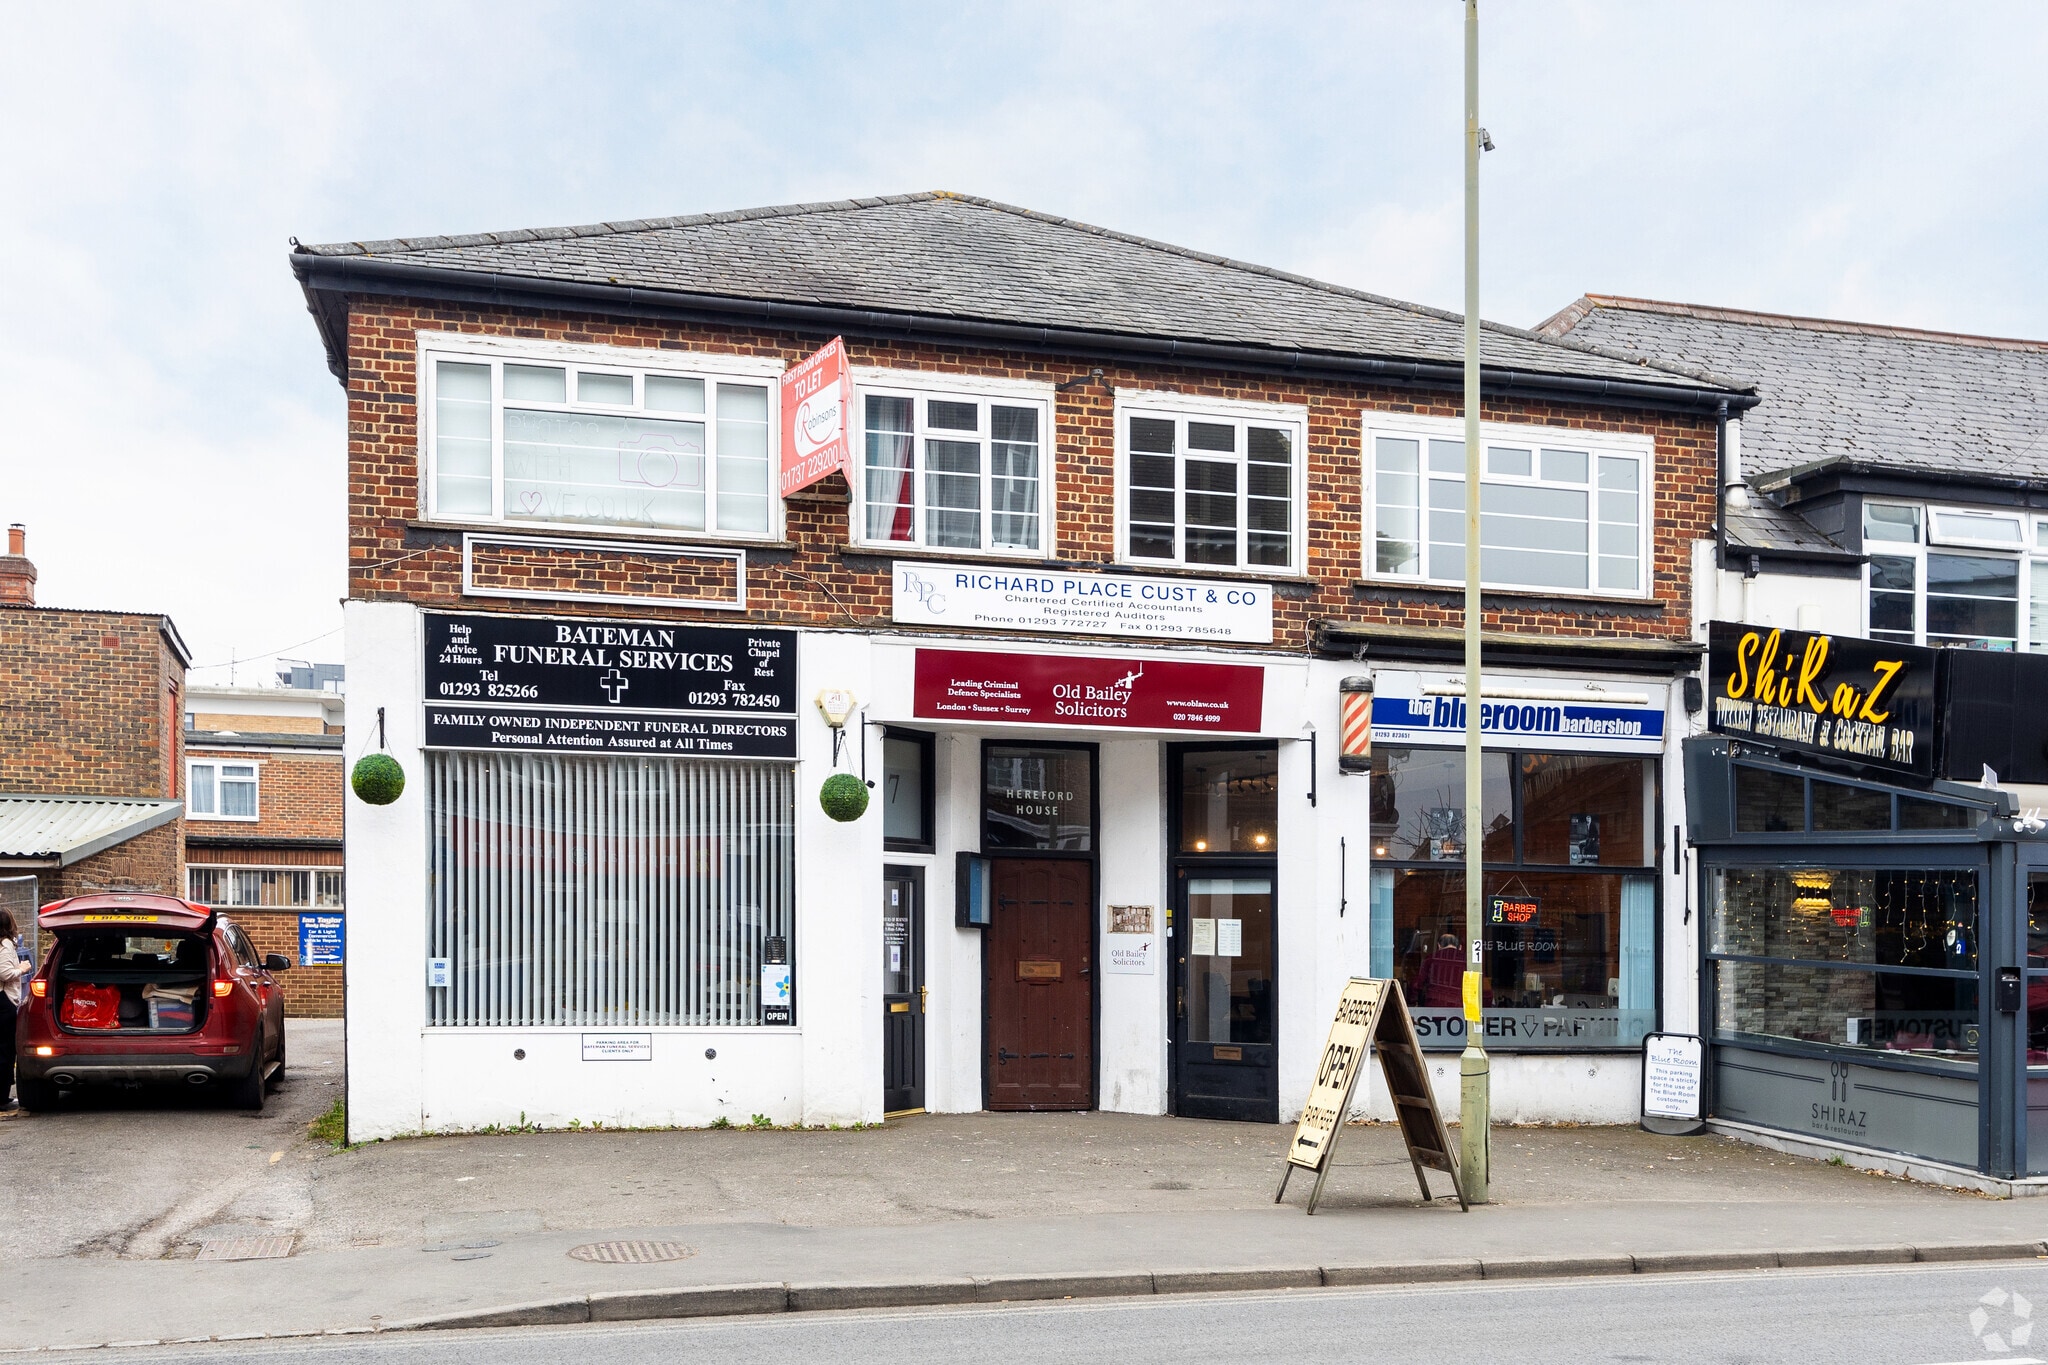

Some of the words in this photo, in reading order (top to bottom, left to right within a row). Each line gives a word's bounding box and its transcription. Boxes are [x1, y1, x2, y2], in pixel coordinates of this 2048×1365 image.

[782, 368, 797, 387] FIRST
[797, 356, 815, 378] FLOOR
[814, 342, 837, 366] OFFICES
[795, 379, 806, 401] TO
[807, 367, 823, 394] LET
[797, 402, 837, 444] Robinsons
[781, 462, 806, 491] 01737
[807, 445, 839, 478] 229200
[955, 574, 1055, 595] RICHARD
[1064, 579, 1133, 599] PLACE
[1141, 583, 1197, 603] CUST
[1205, 589, 1219, 604] &
[1227, 590, 1257, 607] CO
[1005, 594, 1067, 606] Chartered
[1071, 597, 1124, 609] Certified
[1128, 601, 1203, 614] Accountants
[1044, 607, 1110, 620] Registered
[1115, 610, 1166, 622] Auditors
[449, 623, 472, 636] Help
[974, 614, 1014, 625] Phone
[1018, 615, 1057, 626] 01293
[1061, 618, 1107, 629] 772727
[1120, 622, 1141, 632] Fax
[1145, 623, 1183, 634] 01293
[1187, 625, 1232, 636] 785648
[451, 635, 470, 645] and
[555, 625, 675, 648] BATEMAN
[444, 644, 478, 655] Advice
[747, 637, 781, 650] Private
[439, 654, 451, 664] 24
[452, 654, 482, 665] Hours
[494, 644, 612, 668] FUNERAL
[619, 649, 733, 673] SERVICES
[747, 648, 780, 659] Chapel
[758, 657, 769, 668] of
[480, 669, 499, 682] Tel
[753, 667, 774, 677] Rest
[439, 682, 481, 696] 01293
[487, 684, 538, 698] 825266
[723, 679, 745, 692] Fax
[951, 678, 981, 690] Leading
[983, 679, 1019, 690] Criminal
[688, 691, 727, 706] 01293
[732, 693, 780, 708] 782450
[947, 687, 979, 698] Defence
[980, 688, 1021, 701] Specialists
[1053, 683, 1080, 701] Old
[1085, 685, 1132, 704] Bailey
[936, 702, 967, 713] London
[972, 704, 1000, 714] Sussex
[1004, 705, 1031, 716] Surrey
[1055, 701, 1127, 719] Solicitors
[1166, 699, 1229, 710] www.oblaw.co.uk
[1173, 712, 1186, 723] 020
[1187, 713, 1204, 724] 7846
[1204, 714, 1221, 724] 4999
[1408, 699, 1432, 717] the
[1561, 715, 1642, 736] barbershop
[433, 713, 486, 727] FAMILY
[489, 715, 541, 729] OWNED
[545, 717, 640, 732] INDEPENDENT
[644, 720, 708, 735] FUNERAL
[711, 723, 787, 737] DIRECTORS
[1715, 696, 1754, 732] TURKISH
[1755, 703, 1817, 744] RESTAURANT
[1834, 718, 1887, 759] COCKTAIL
[1889, 728, 1914, 764] BAR
[491, 731, 543, 746] Personal
[546, 732, 603, 747] Attention
[608, 735, 656, 748] Assured
[659, 738, 671, 749] at
[675, 737, 694, 750] All
[697, 738, 733, 751] Times
[888, 774, 900, 804] 7
[1006, 789, 1074, 801] HEREFORD
[1016, 805, 1059, 816] HOUSE
[1503, 902, 1537, 914] BARBER
[1507, 913, 1532, 922] SHOP
[1474, 941, 1482, 951] 2
[1496, 940, 1525, 950] BLUE
[1527, 941, 1560, 951] ROOM
[1111, 950, 1124, 958] Old
[1126, 950, 1147, 959] Bailey
[1475, 952, 1480, 961] 1
[1112, 958, 1146, 966] Solicitors
[766, 1012, 788, 1021] OPEN
[1334, 998, 1376, 1027] BARBERS
[1412, 1015, 1517, 1037] STOER
[1668, 1048, 1682, 1056] The
[1318, 1043, 1359, 1090] OPEN
[1651, 1055, 1671, 1063] Blue
[1673, 1058, 1698, 1066] Room
[1670, 1070, 1693, 1078] parking
[1676, 1076, 1698, 1085] strictly
[1657, 1096, 1689, 1104] customers
[1811, 1103, 1867, 1128] SHIRAZ
[1811, 1121, 1823, 1129] bar
[1824, 1123, 1829, 1131] &
[1830, 1126, 1866, 1137] restaurant
